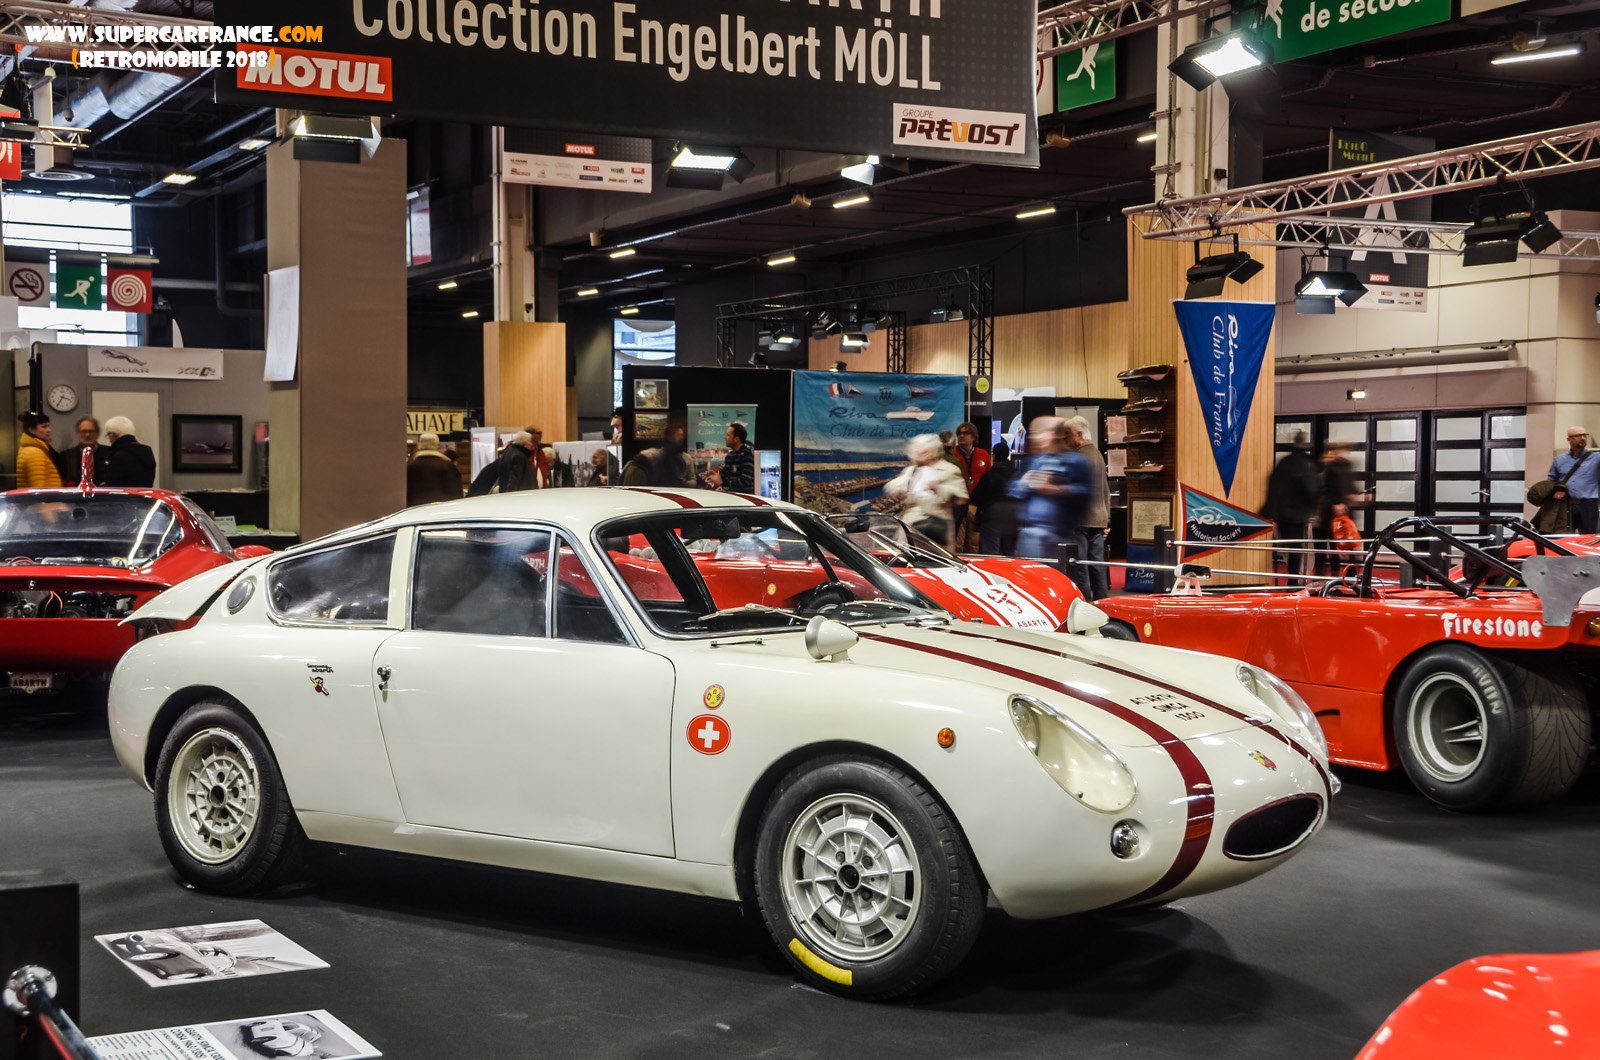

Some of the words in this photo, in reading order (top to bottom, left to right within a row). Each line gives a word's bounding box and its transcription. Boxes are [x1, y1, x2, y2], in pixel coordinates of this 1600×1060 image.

[1300, 2, 1331, 33] de
[1338, 0, 1421, 23] seco
[352, 0, 597, 58] Collection
[614, 2, 821, 82] Engelbert
[835, 18, 941, 91] MÖLL
[244, 53, 386, 94] MOTUL
[902, 108, 935, 119] GROUPE
[566, 145, 594, 154] MOTUL
[1370, 274, 1389, 282] MOTUL
[1212, 315, 1225, 360] Club
[1228, 313, 1239, 375] Riva
[1213, 365, 1226, 384] de
[829, 406, 878, 419] Riva
[1213, 390, 1226, 447] France
[829, 423, 866, 438] Club
[870, 424, 885, 438] de
[1198, 513, 1238, 526] Riva
[1190, 524, 1219, 543] Historical
[1219, 526, 1242, 543] Society
[1016, 619, 1048, 628] ABARTH
[1440, 612, 1543, 638] Firestone
[12, 678, 48, 687] ABARTH
